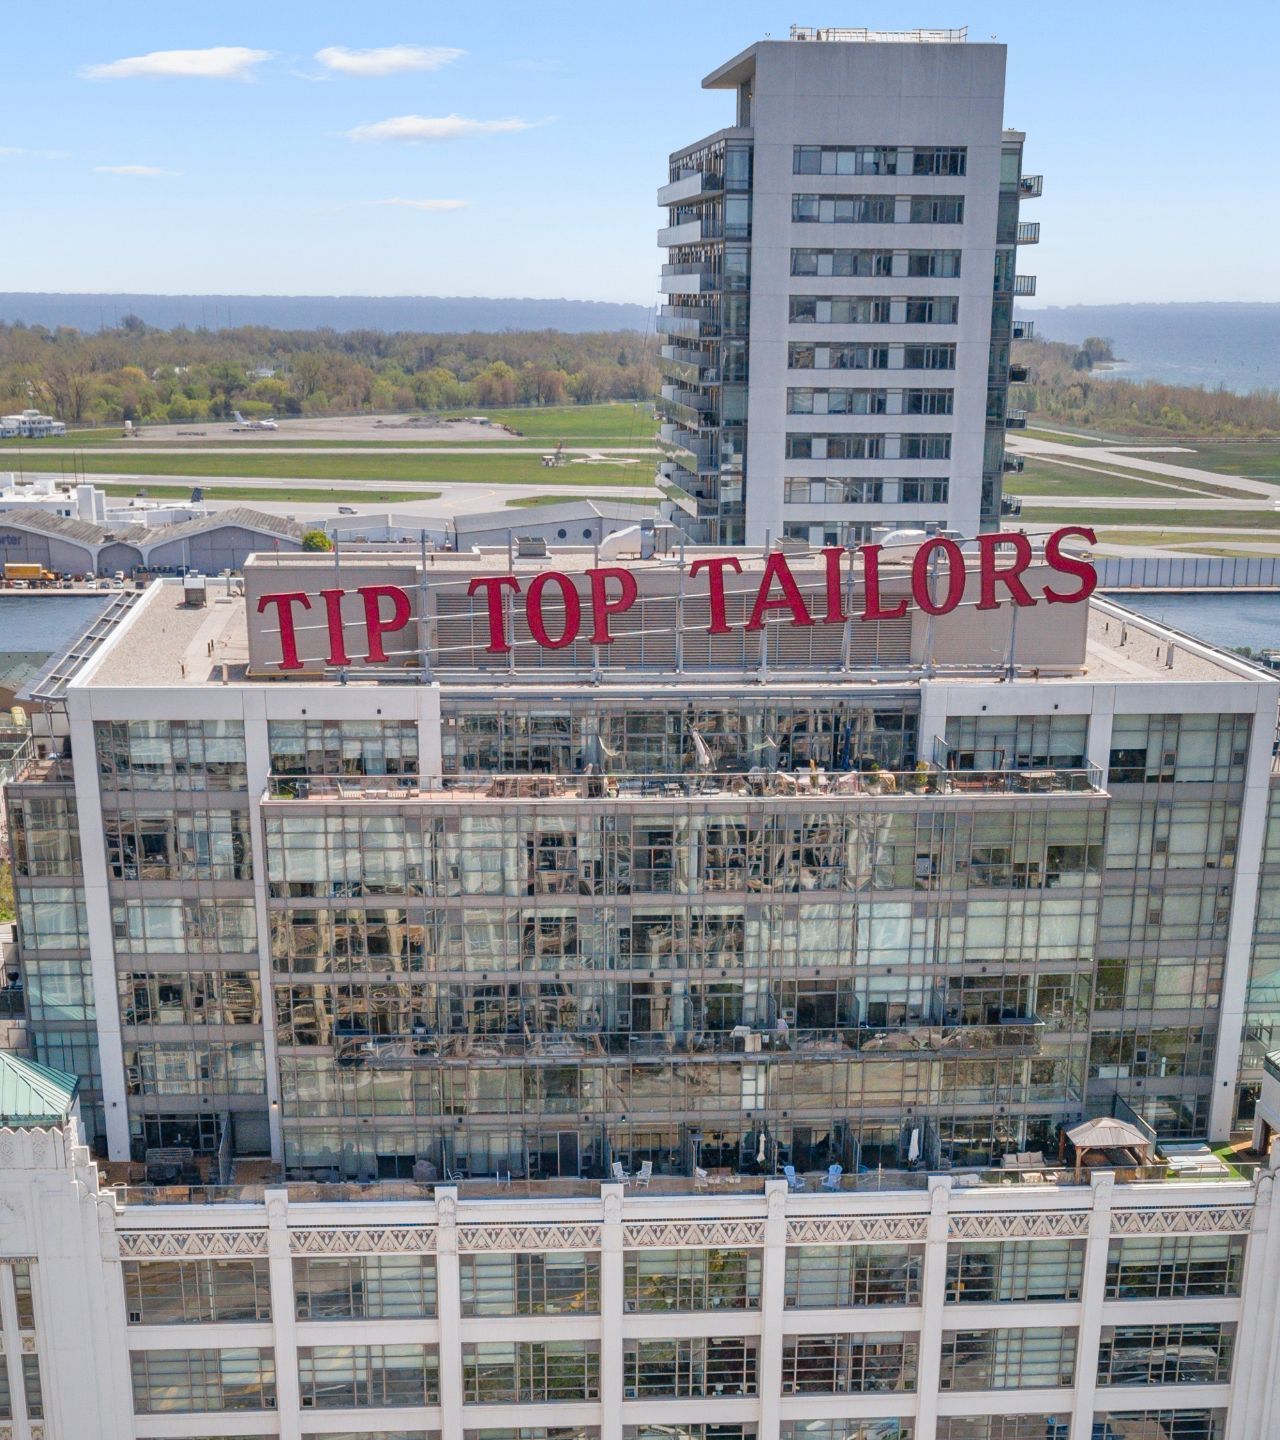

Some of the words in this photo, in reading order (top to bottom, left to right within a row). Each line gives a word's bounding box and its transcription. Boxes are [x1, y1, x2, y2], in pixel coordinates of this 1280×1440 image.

[257, 584, 411, 670] TIP
[467, 567, 638, 654] TOP
[689, 525, 1099, 635] TAILORS
